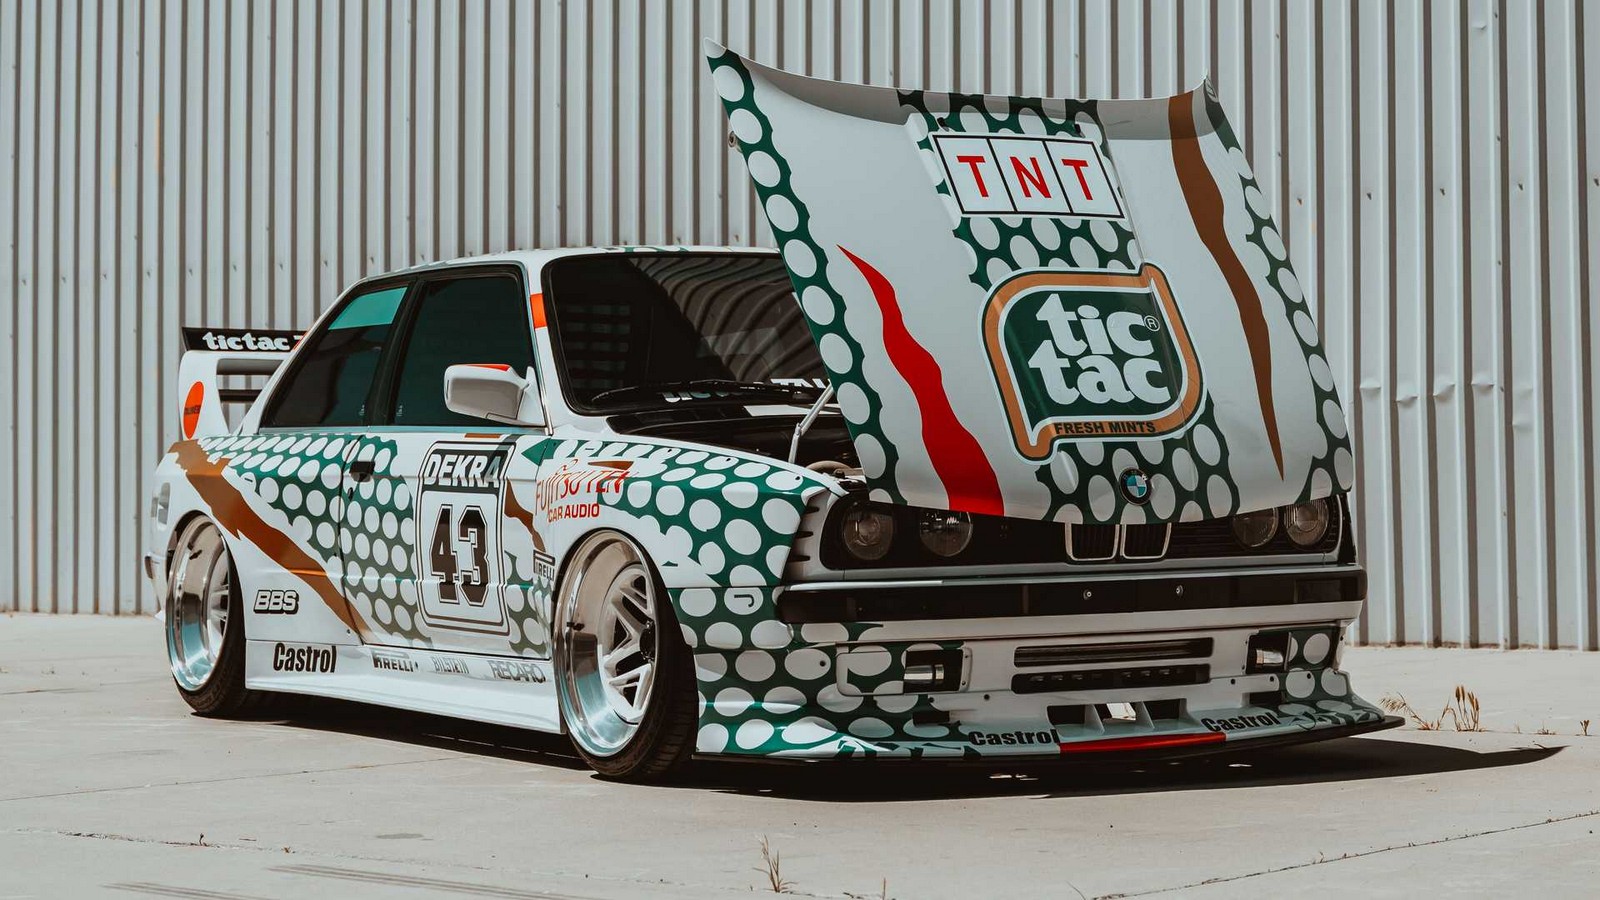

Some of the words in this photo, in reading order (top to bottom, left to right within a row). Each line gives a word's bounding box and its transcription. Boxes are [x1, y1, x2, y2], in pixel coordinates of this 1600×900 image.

[957, 155, 1093, 200] TNT
[1036, 294, 1154, 356] tic
[1028, 340, 1171, 405] tac
[1053, 421, 1105, 435] FRESH
[1108, 420, 1156, 433] MINTS
[423, 454, 500, 488] DEKRA
[548, 506, 563, 523] CAR
[564, 502, 600, 519] AUDIO
[430, 503, 490, 608] 43
[253, 589, 299, 614] BBS
[273, 642, 337, 673] Castrol
[430, 656, 470, 675] BILSTEIN
[486, 659, 546, 684] RECARO
[1201, 711, 1281, 732] Castrol
[968, 728, 1061, 746] Castrol
